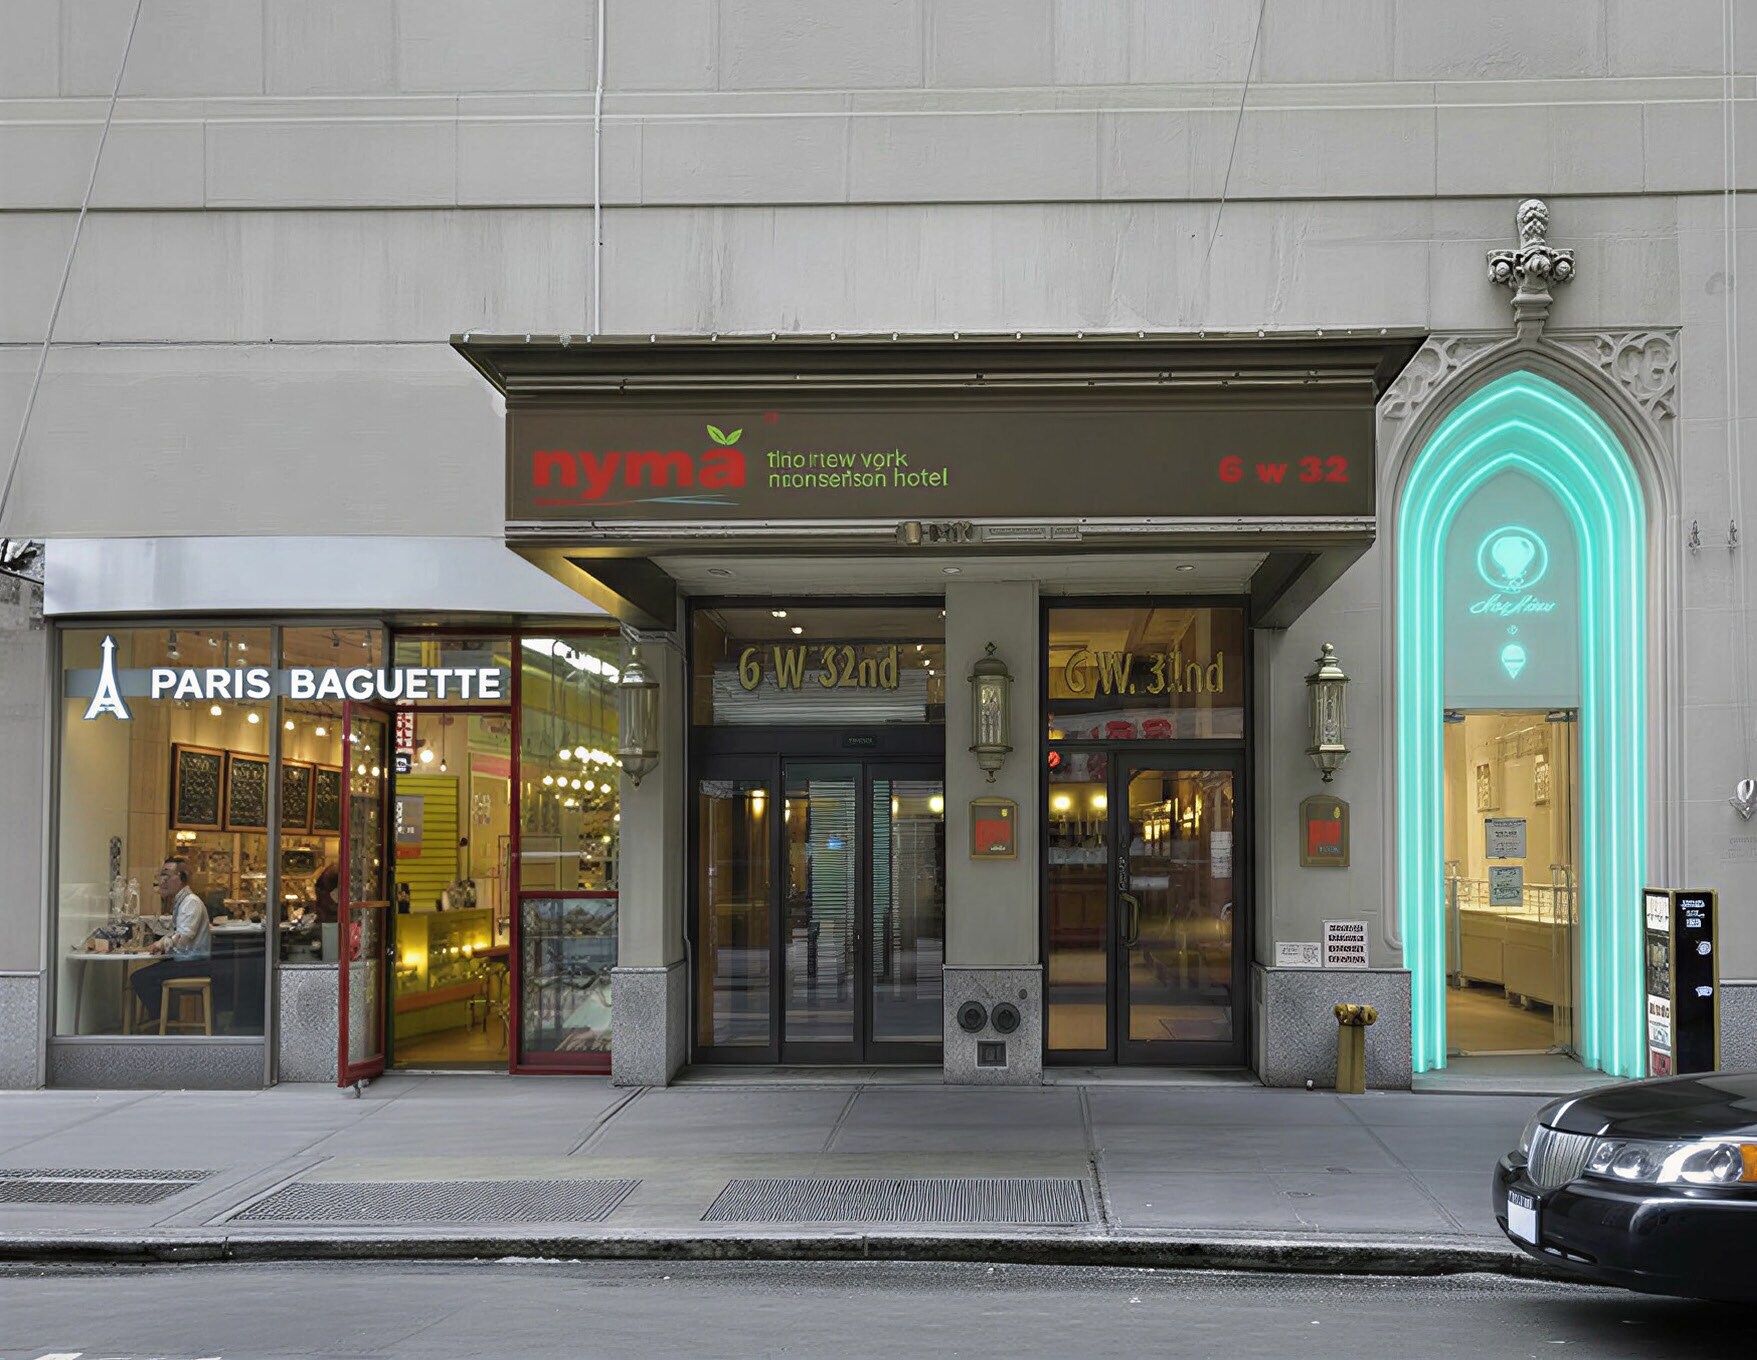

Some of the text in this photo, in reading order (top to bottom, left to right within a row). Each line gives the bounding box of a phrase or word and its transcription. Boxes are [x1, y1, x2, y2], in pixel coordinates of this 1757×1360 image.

[533, 448, 746, 500] nyma
[894, 467, 949, 487] hotel
[1218, 455, 1350, 484] 6 w 32
[151, 668, 501, 700] PARIS BAGUETTE
[738, 646, 762, 691] 6
[773, 645, 807, 689] W
